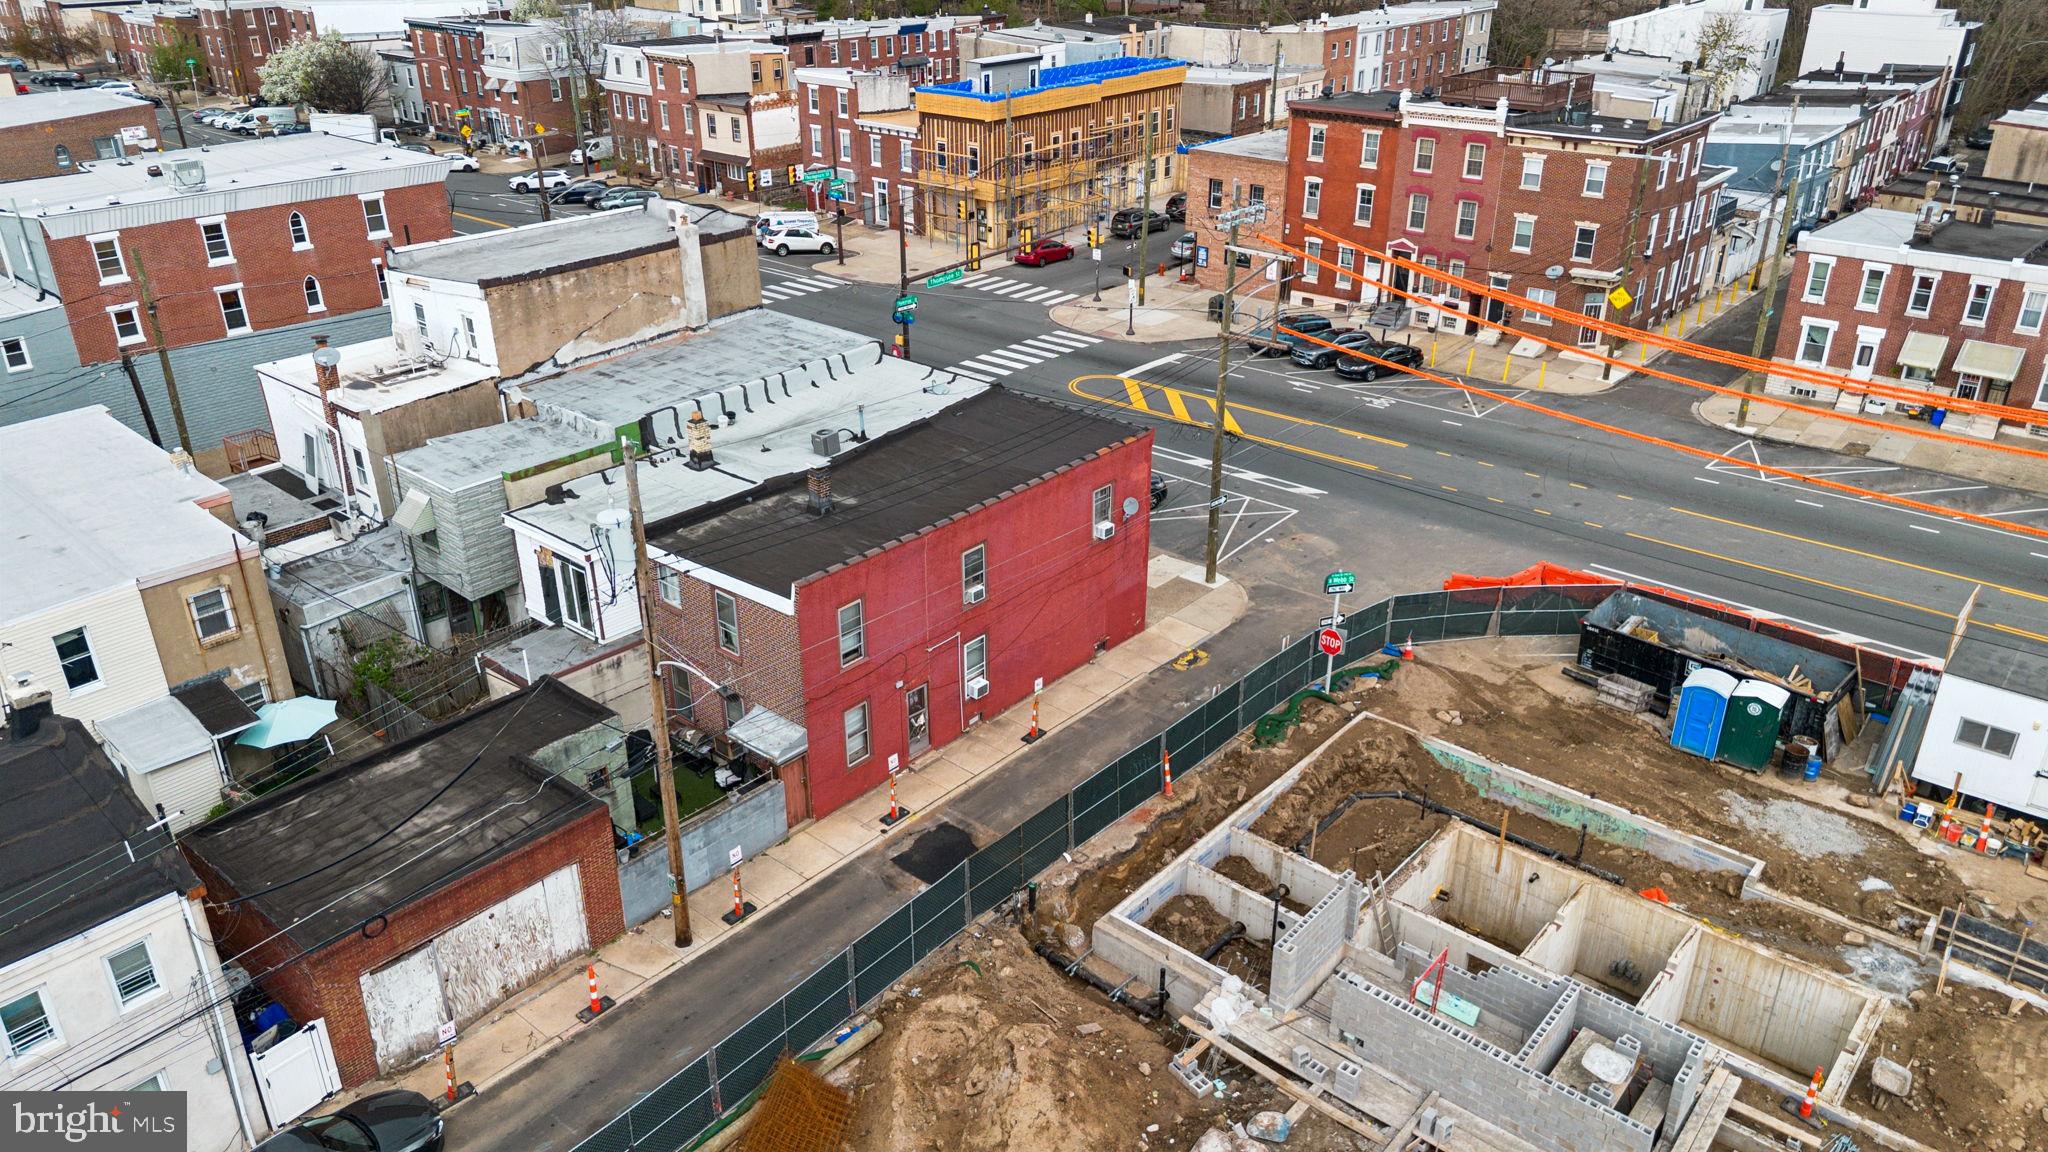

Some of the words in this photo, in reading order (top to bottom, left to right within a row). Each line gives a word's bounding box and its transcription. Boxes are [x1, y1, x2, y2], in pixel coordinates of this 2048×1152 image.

[930, 272, 954, 285] Thompson
[1321, 635, 1341, 649] STOP
[441, 1026, 452, 1036] NO
